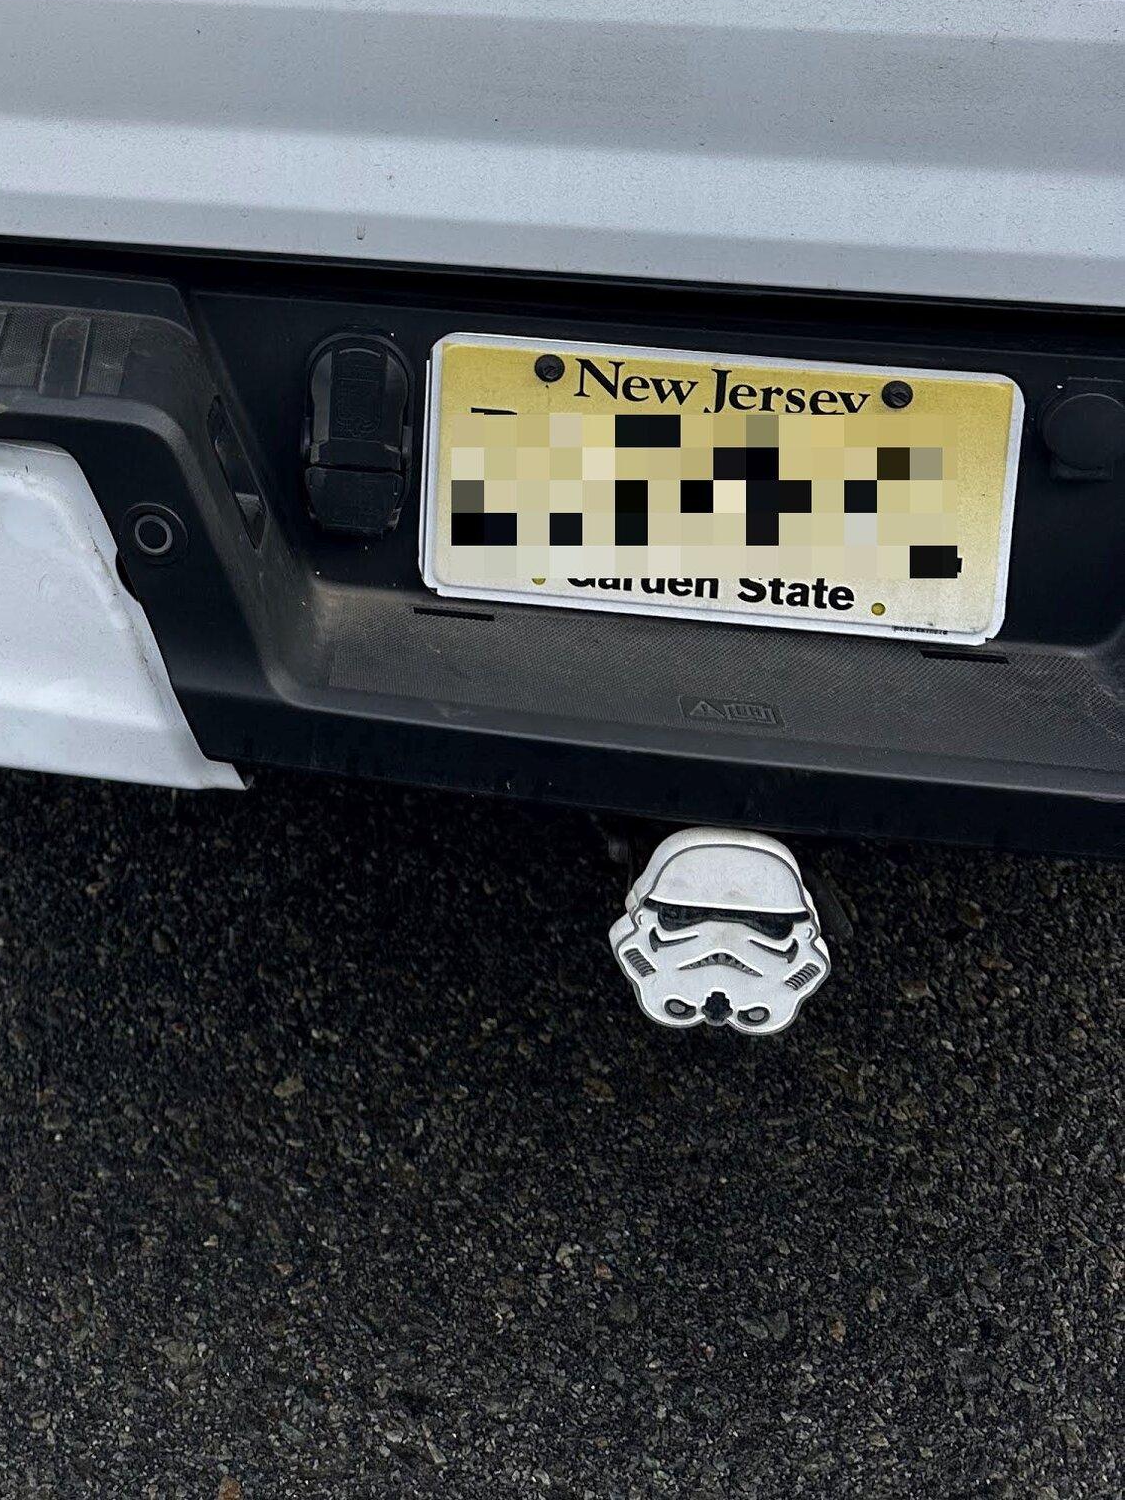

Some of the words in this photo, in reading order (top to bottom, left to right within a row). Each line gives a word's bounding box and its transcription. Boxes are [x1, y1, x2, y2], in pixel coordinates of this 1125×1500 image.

[574, 358, 699, 405] New
[703, 368, 871, 415] Jersey
[737, 577, 855, 611] State
